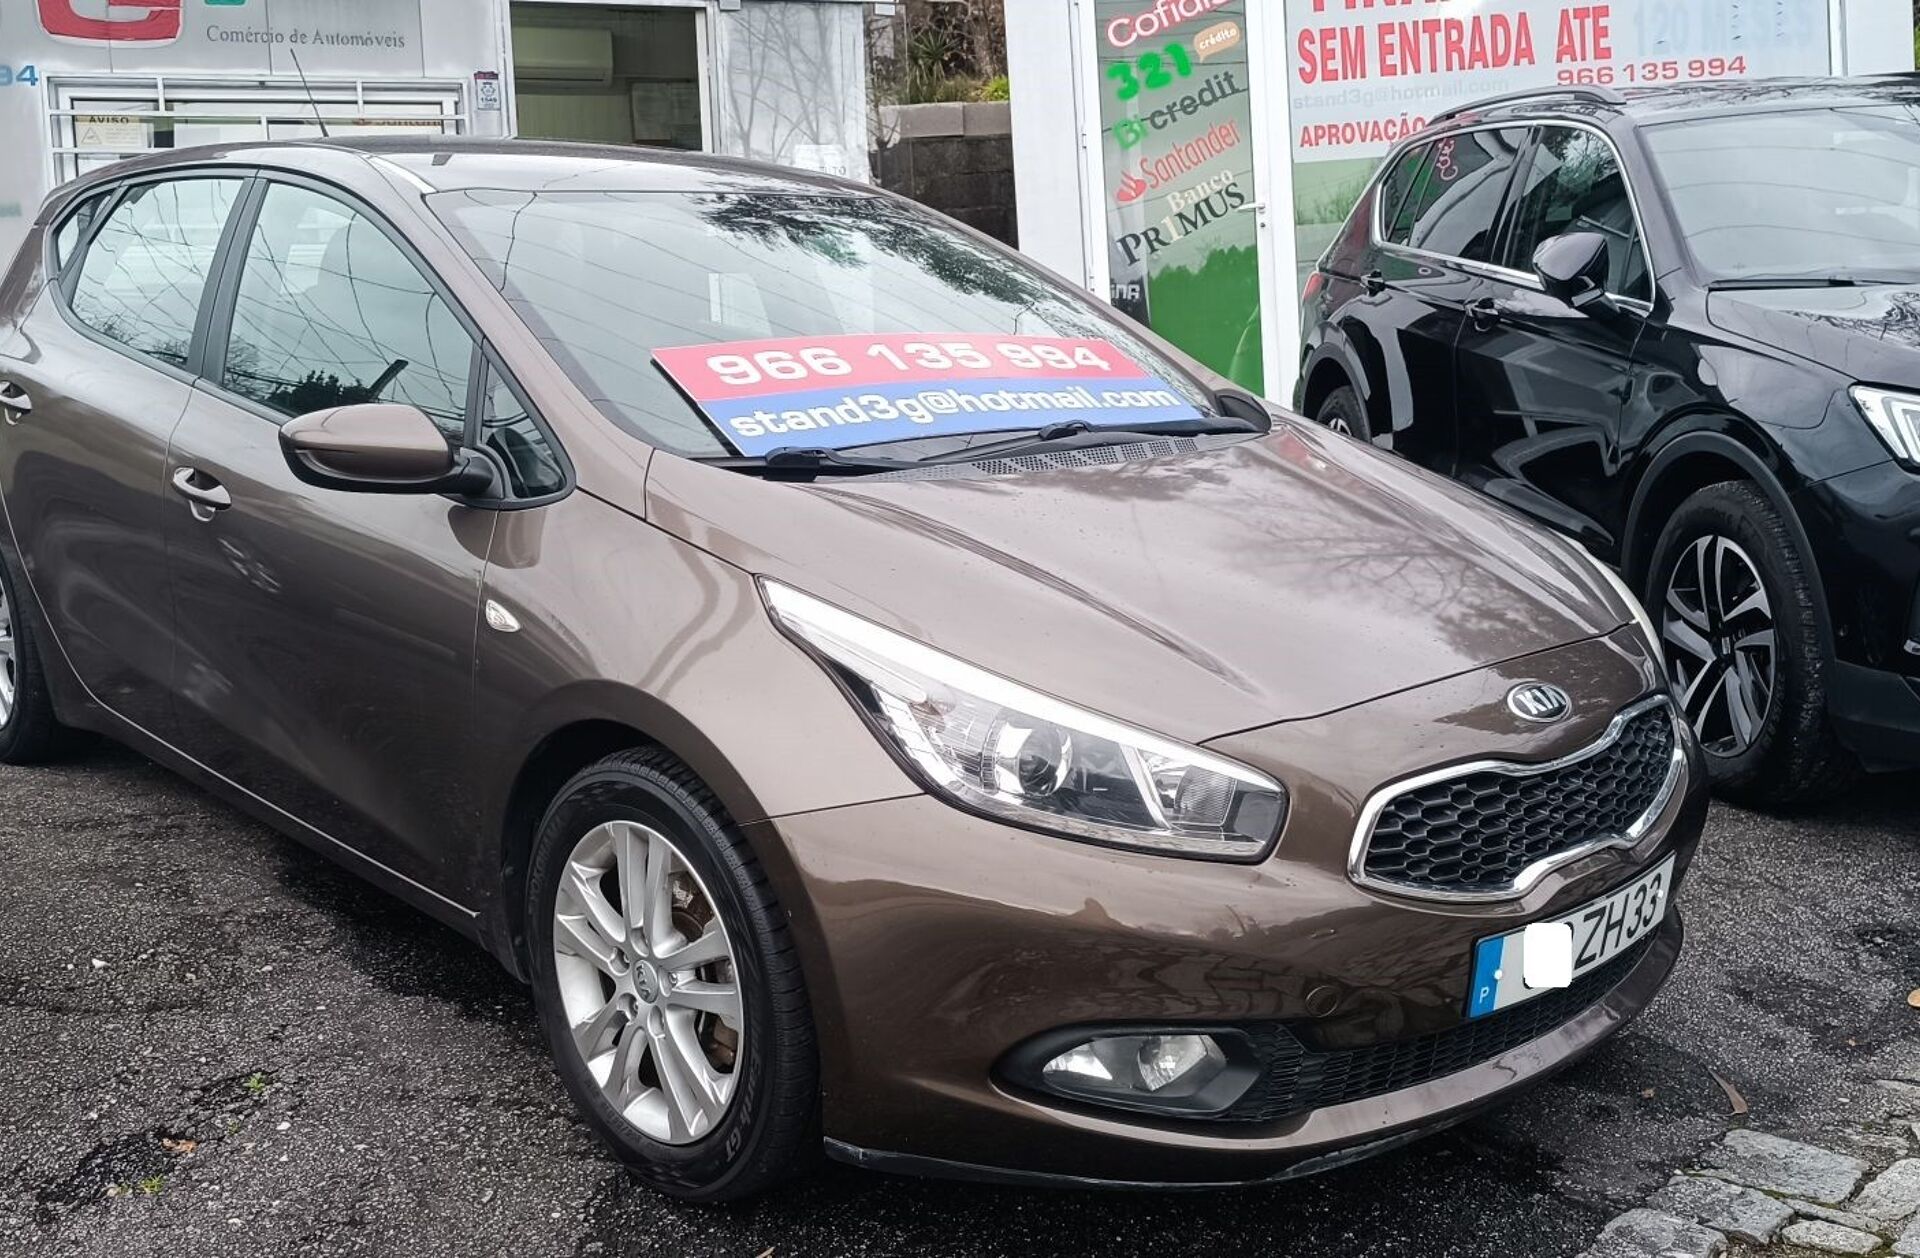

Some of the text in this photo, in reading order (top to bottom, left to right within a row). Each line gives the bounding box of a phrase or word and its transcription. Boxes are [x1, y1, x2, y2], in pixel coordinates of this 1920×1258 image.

[206, 25, 406, 49] Comércio de Automóveis
[1297, 25, 1368, 85] SEM
[1377, 11, 1536, 77] ENTRADA
[1106, 42, 1193, 101] 321
[1557, 56, 1747, 86] 966 135 994
[1300, 113, 1427, 148] APROVAÇÃO
[1141, 118, 1242, 190] Santander
[1166, 169, 1233, 213] Banco
[706, 341, 1112, 386] 966 135 994
[730, 386, 1181, 435] stand3g@hotmail.com
[1515, 688, 1567, 715] KIA
[1479, 986, 1490, 1004] P
